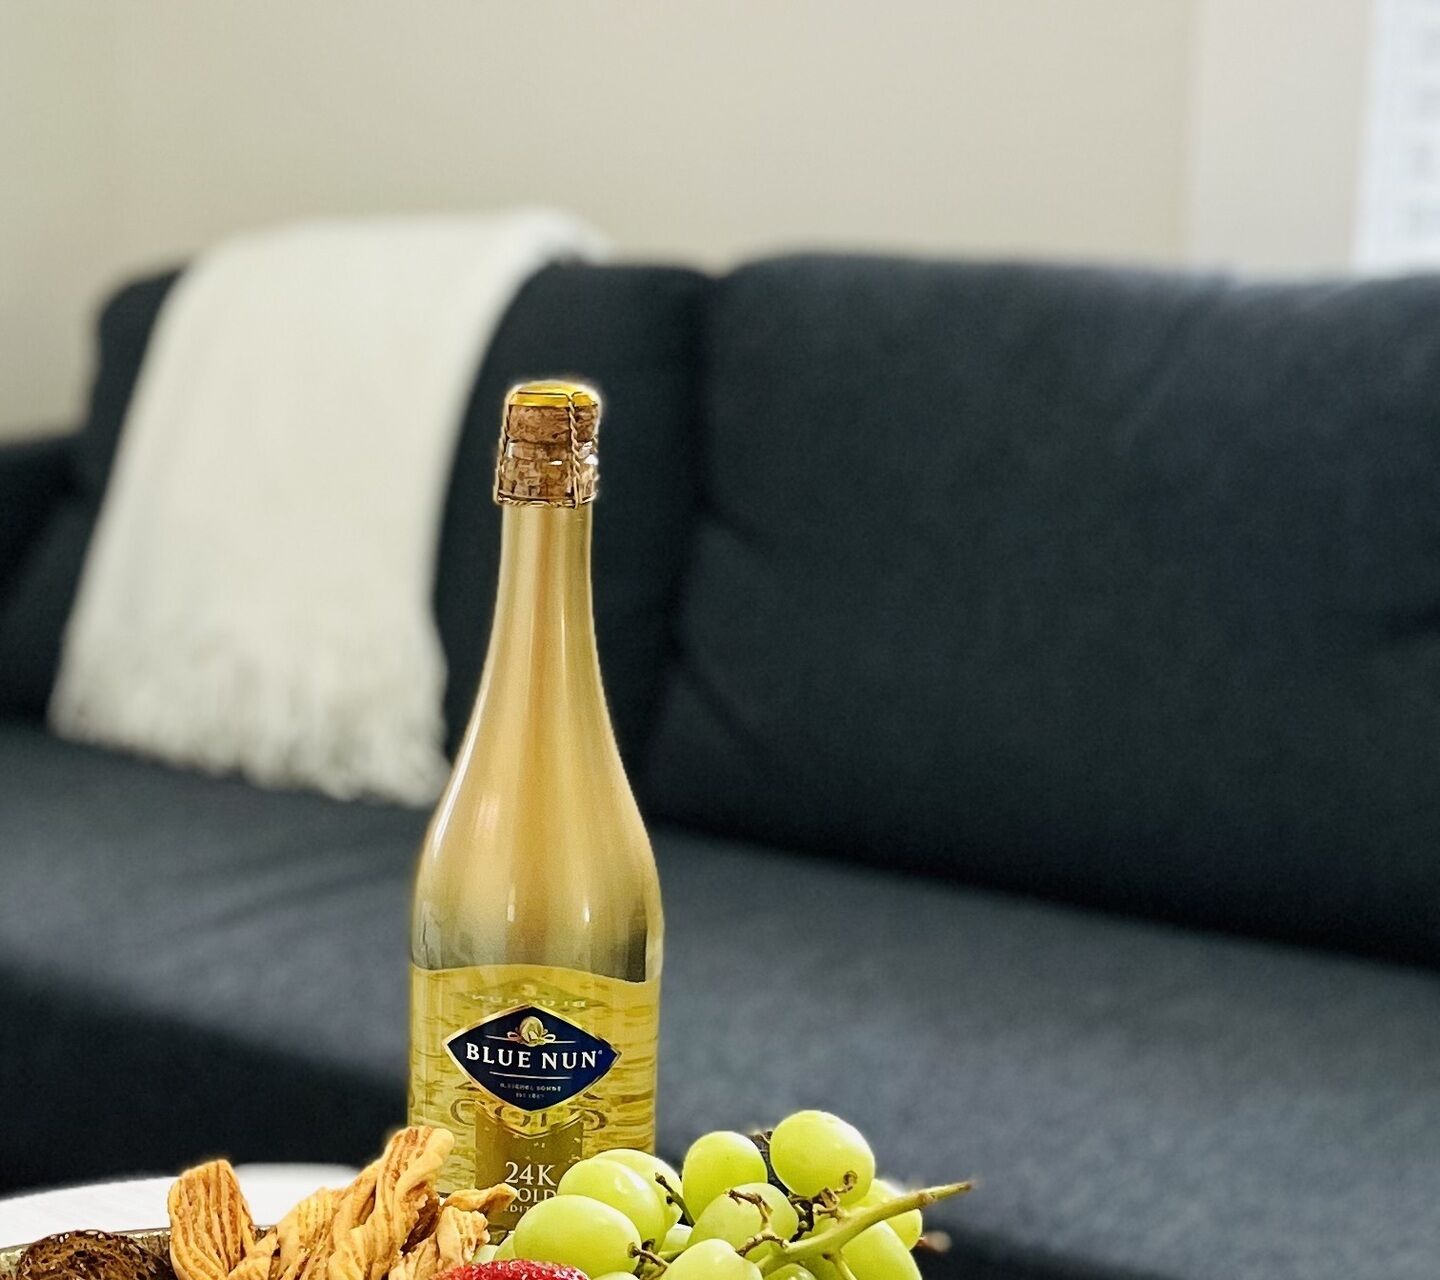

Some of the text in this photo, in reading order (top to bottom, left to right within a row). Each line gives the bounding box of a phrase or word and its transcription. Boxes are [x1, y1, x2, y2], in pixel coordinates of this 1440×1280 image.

[466, 1042, 597, 1070] BLUE NUN
[504, 1161, 557, 1186] 24K
[517, 1187, 557, 1203] OLD
